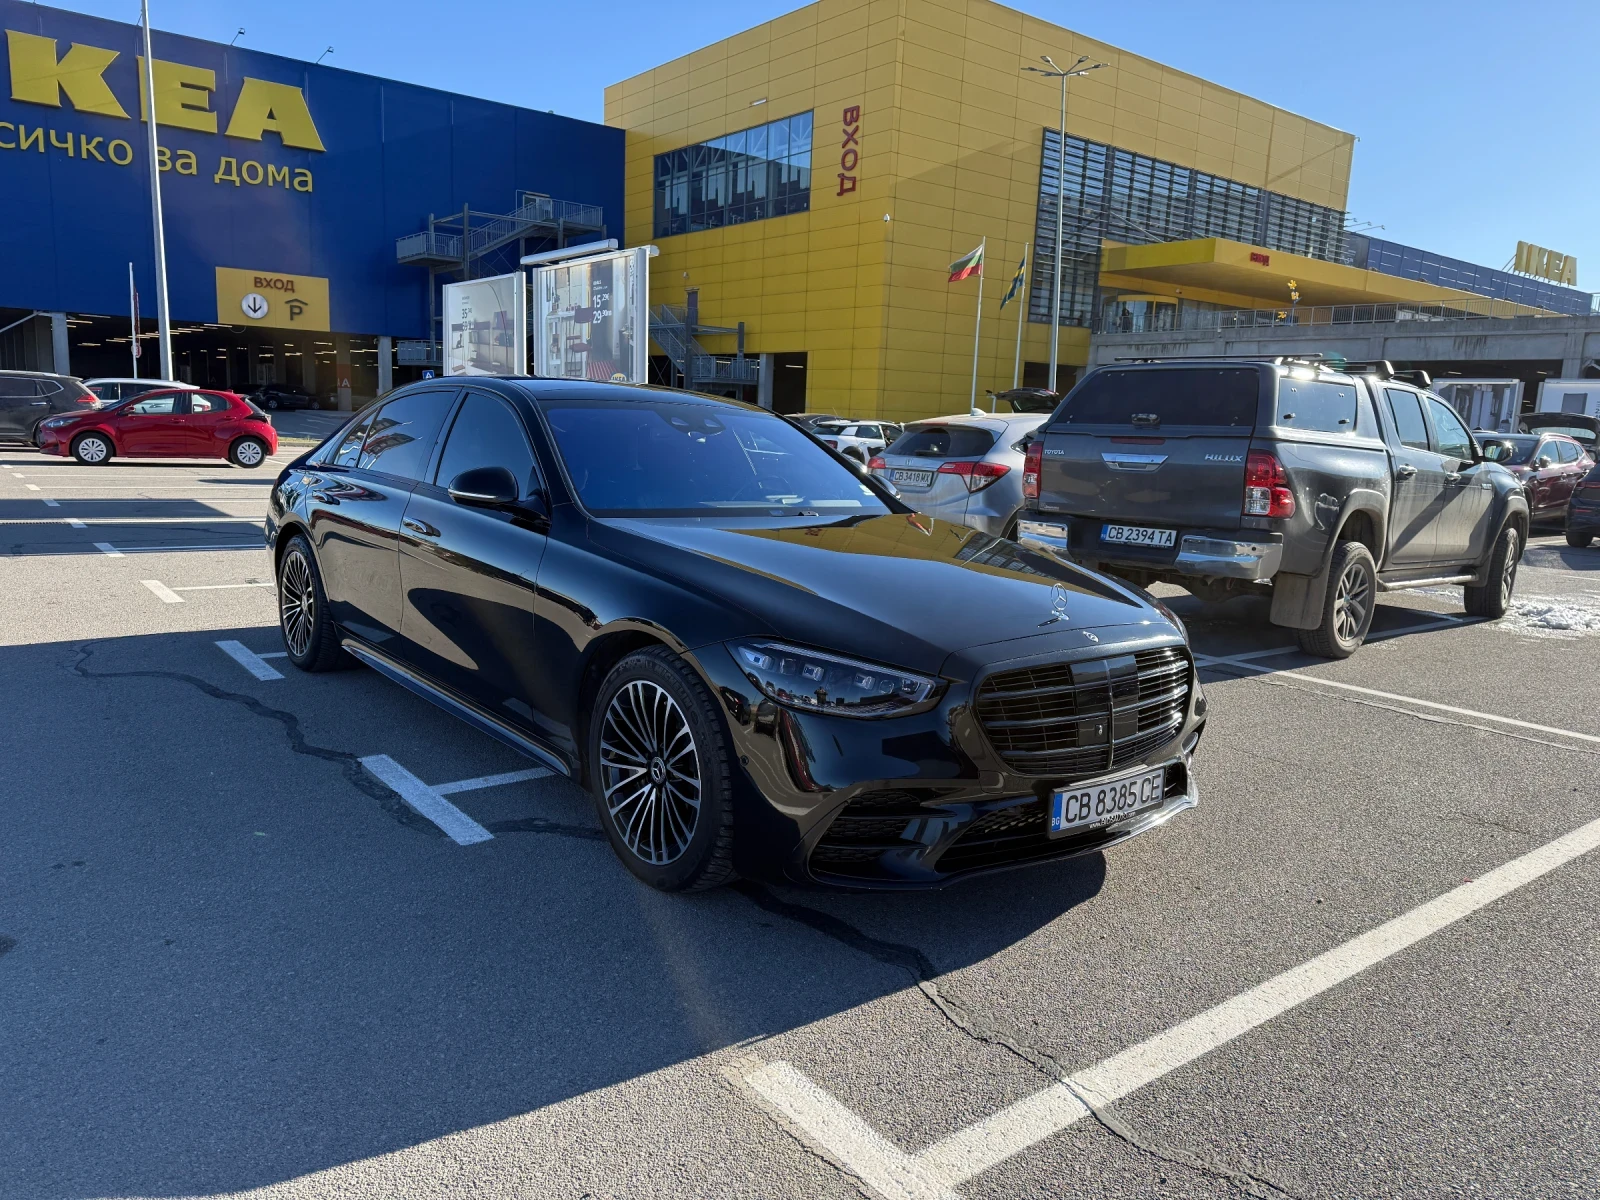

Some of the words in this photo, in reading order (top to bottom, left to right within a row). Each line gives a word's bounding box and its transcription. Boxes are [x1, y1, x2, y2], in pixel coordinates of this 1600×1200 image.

[836, 105, 860, 197] ВХОД
[156, 146, 198, 176] за
[214, 156, 313, 193] дома
[1513, 240, 1578, 287] IKEA
[253, 276, 295, 293] ВХОД
[1204, 453, 1243, 462] HILUX
[894, 471, 904, 481] CB
[1108, 526, 1124, 540] CB
[1125, 528, 1155, 543] 2394
[1158, 530, 1172, 545] TA
[1065, 792, 1091, 824] CB
[1095, 780, 1138, 817] 8385
[1140, 773, 1162, 804] CE
[1051, 816, 1060, 827] BG
